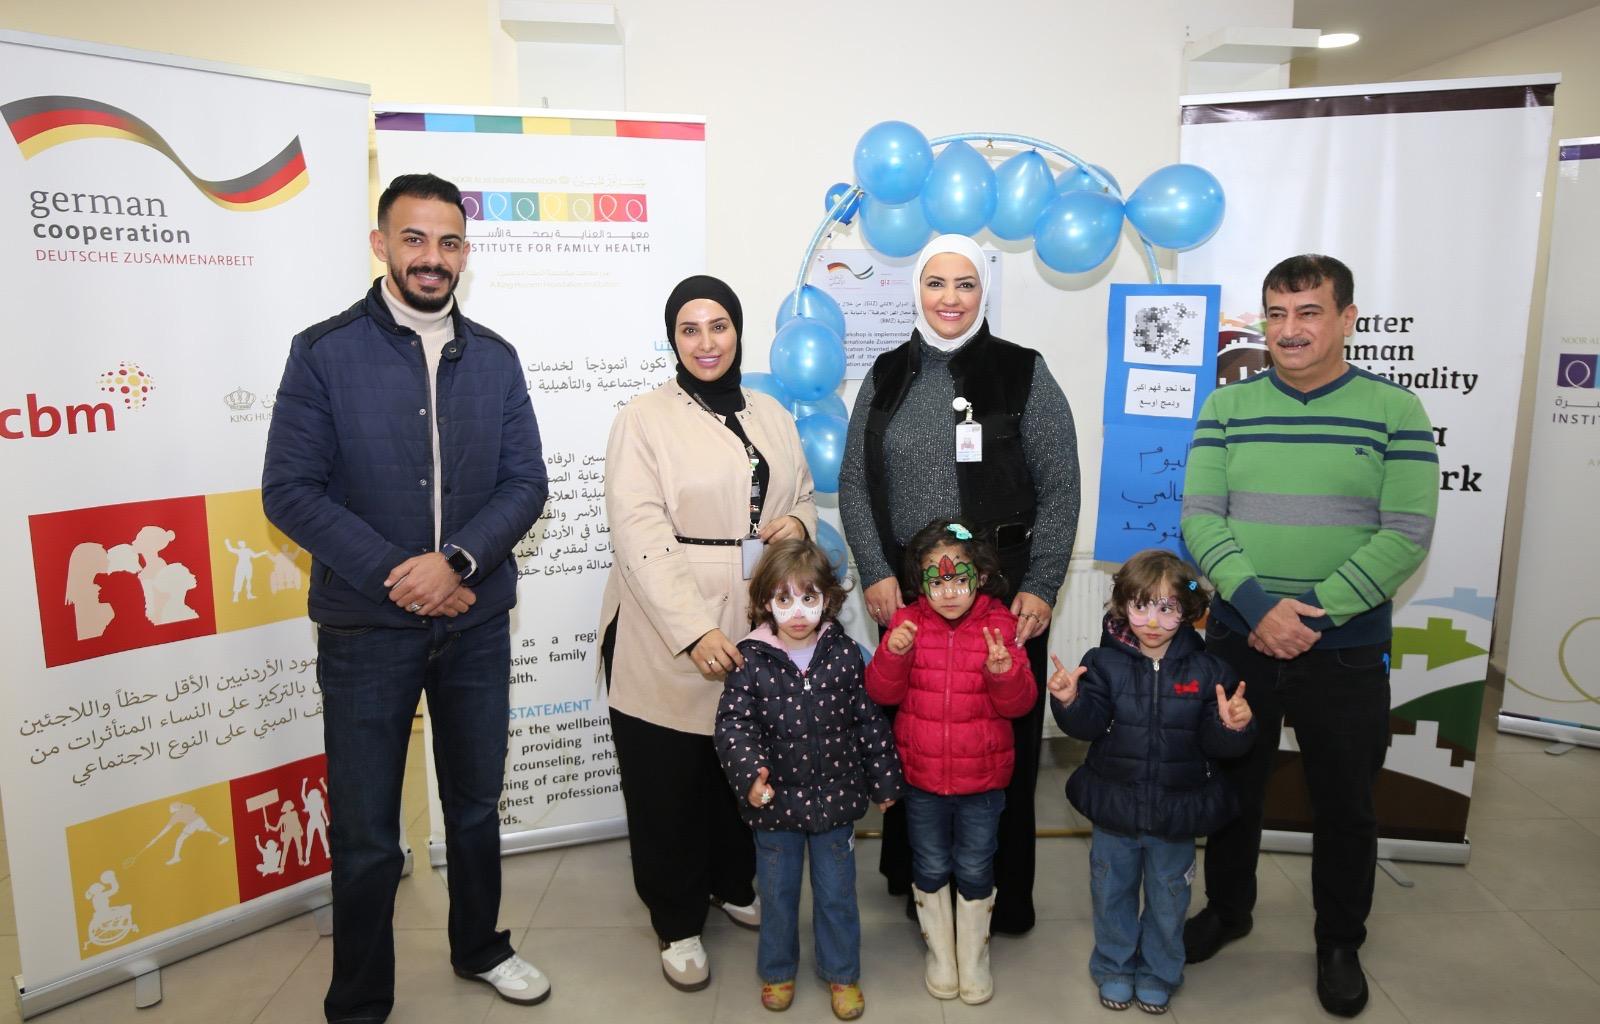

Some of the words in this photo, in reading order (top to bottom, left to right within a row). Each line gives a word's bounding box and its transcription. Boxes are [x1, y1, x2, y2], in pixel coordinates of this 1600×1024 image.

[30, 190, 168, 219] german
[33, 222, 191, 245] cooperation
[35, 249, 118, 263] DEUTSCHE
[123, 251, 255, 267] ZUSAMMENARBEIT
[471, 243, 523, 253] STITUTE
[528, 243, 552, 253] FOR
[557, 243, 600, 253] FAMILY
[605, 243, 651, 253] HEALTH
[1355, 314, 1414, 333] ater
[527, 360, 574, 372] لخدمات
[0, 393, 116, 440] cbm
[230, 413, 254, 423] KING
[582, 453, 606, 466] سين
[577, 469, 606, 483] رعاية
[1440, 464, 1483, 492] rk
[542, 525, 574, 540] الأردن
[549, 542, 588, 562] لمقدمي
[516, 565, 541, 581] حقو
[544, 562, 583, 576] ومبادئ
[522, 638, 536, 648] as
[551, 636, 559, 645] a
[575, 629, 598, 643] regi
[549, 648, 587, 662] family
[217, 658, 284, 692] الأردنيين
[288, 657, 318, 674] مود
[508, 671, 537, 685] alth.
[165, 674, 209, 703] الأقل
[254, 680, 306, 710] بالتركيز
[160, 701, 211, 728] النساء
[218, 696, 251, 719] على
[510, 698, 592, 720] STATEMENT
[19, 699, 111, 737] واللاجئين
[253, 707, 298, 740] المبني
[528, 723, 551, 735] the
[556, 715, 611, 732] wellbein
[67, 715, 153, 750] المتأثرات
[216, 723, 248, 746] على
[30, 744, 60, 765] من
[168, 729, 209, 760] النوع
[521, 737, 582, 756] providing
[72, 740, 161, 787] الاجتماعي
[513, 754, 585, 773] counseling,
[534, 774, 548, 787] of
[552, 772, 579, 784] care
[499, 794, 535, 812] ghest
